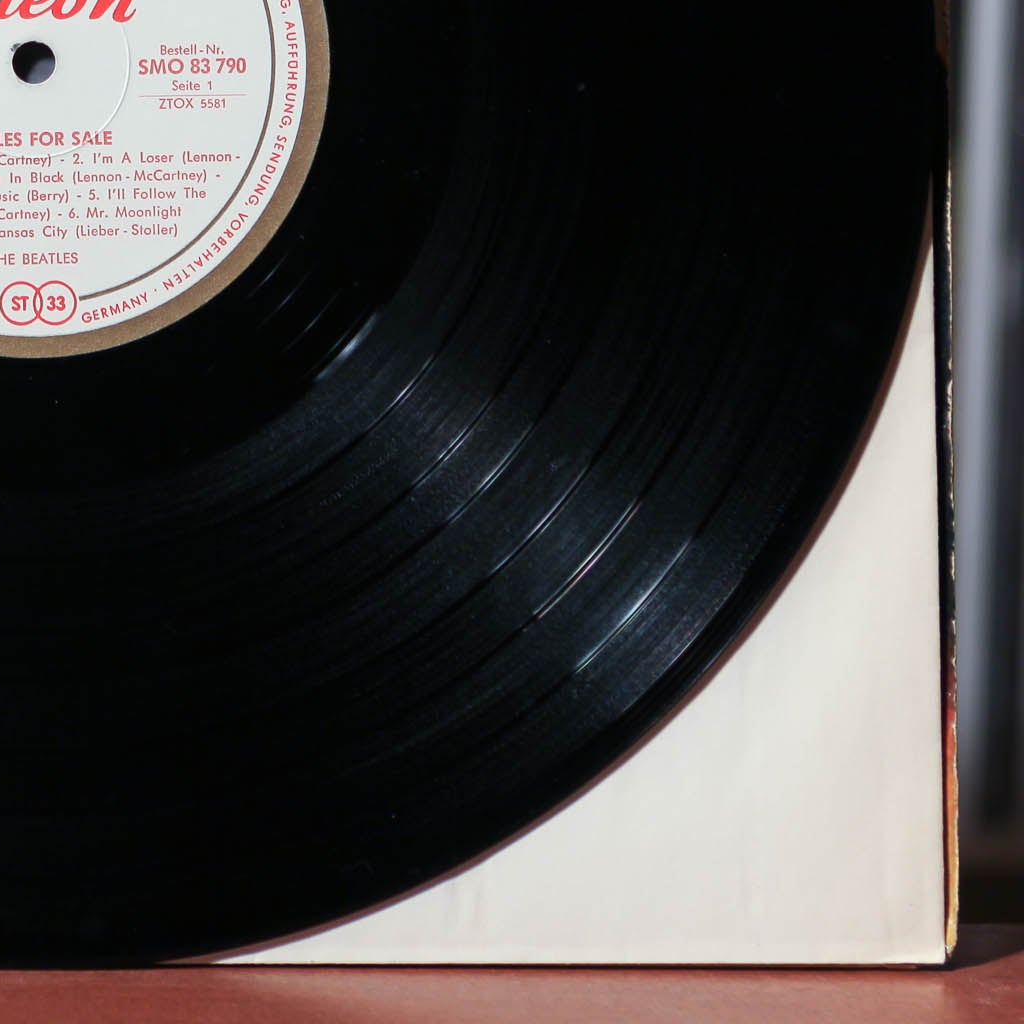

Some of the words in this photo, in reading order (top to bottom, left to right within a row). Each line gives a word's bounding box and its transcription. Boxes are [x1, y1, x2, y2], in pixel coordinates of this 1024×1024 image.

[138, 58, 184, 75] SMO
[190, 58, 210, 74] 83
[216, 57, 246, 74] 790
[172, 80, 200, 91] Seite
[208, 80, 212, 90] 1
[159, 98, 194, 109] ZTOX
[201, 98, 225, 108] 5581
[30, 132, 64, 146] FOR
[72, 130, 112, 146] SALE
[73, 153, 83, 164] 2.
[94, 152, 112, 164] I'm
[121, 152, 131, 164] A
[140, 152, 174, 163] Loser
[10, 172, 21, 184] In
[31, 171, 64, 183] Black
[245, 135, 287, 206] SENDUNG,
[27, 189, 68, 204] (Berry)
[89, 189, 99, 200] 5.
[134, 188, 176, 200] Follow
[184, 187, 206, 199] The
[68, 208, 79, 219] 6.
[86, 207, 108, 218] Mr.
[115, 205, 181, 220] Moonlight
[43, 225, 67, 240] City
[22, 252, 78, 265] BEATLES
[162, 213, 248, 290] VORBEHALTEN
[11, 296, 29, 311] ST
[46, 295, 66, 311] 33
[81, 291, 147, 323] GERMANY
